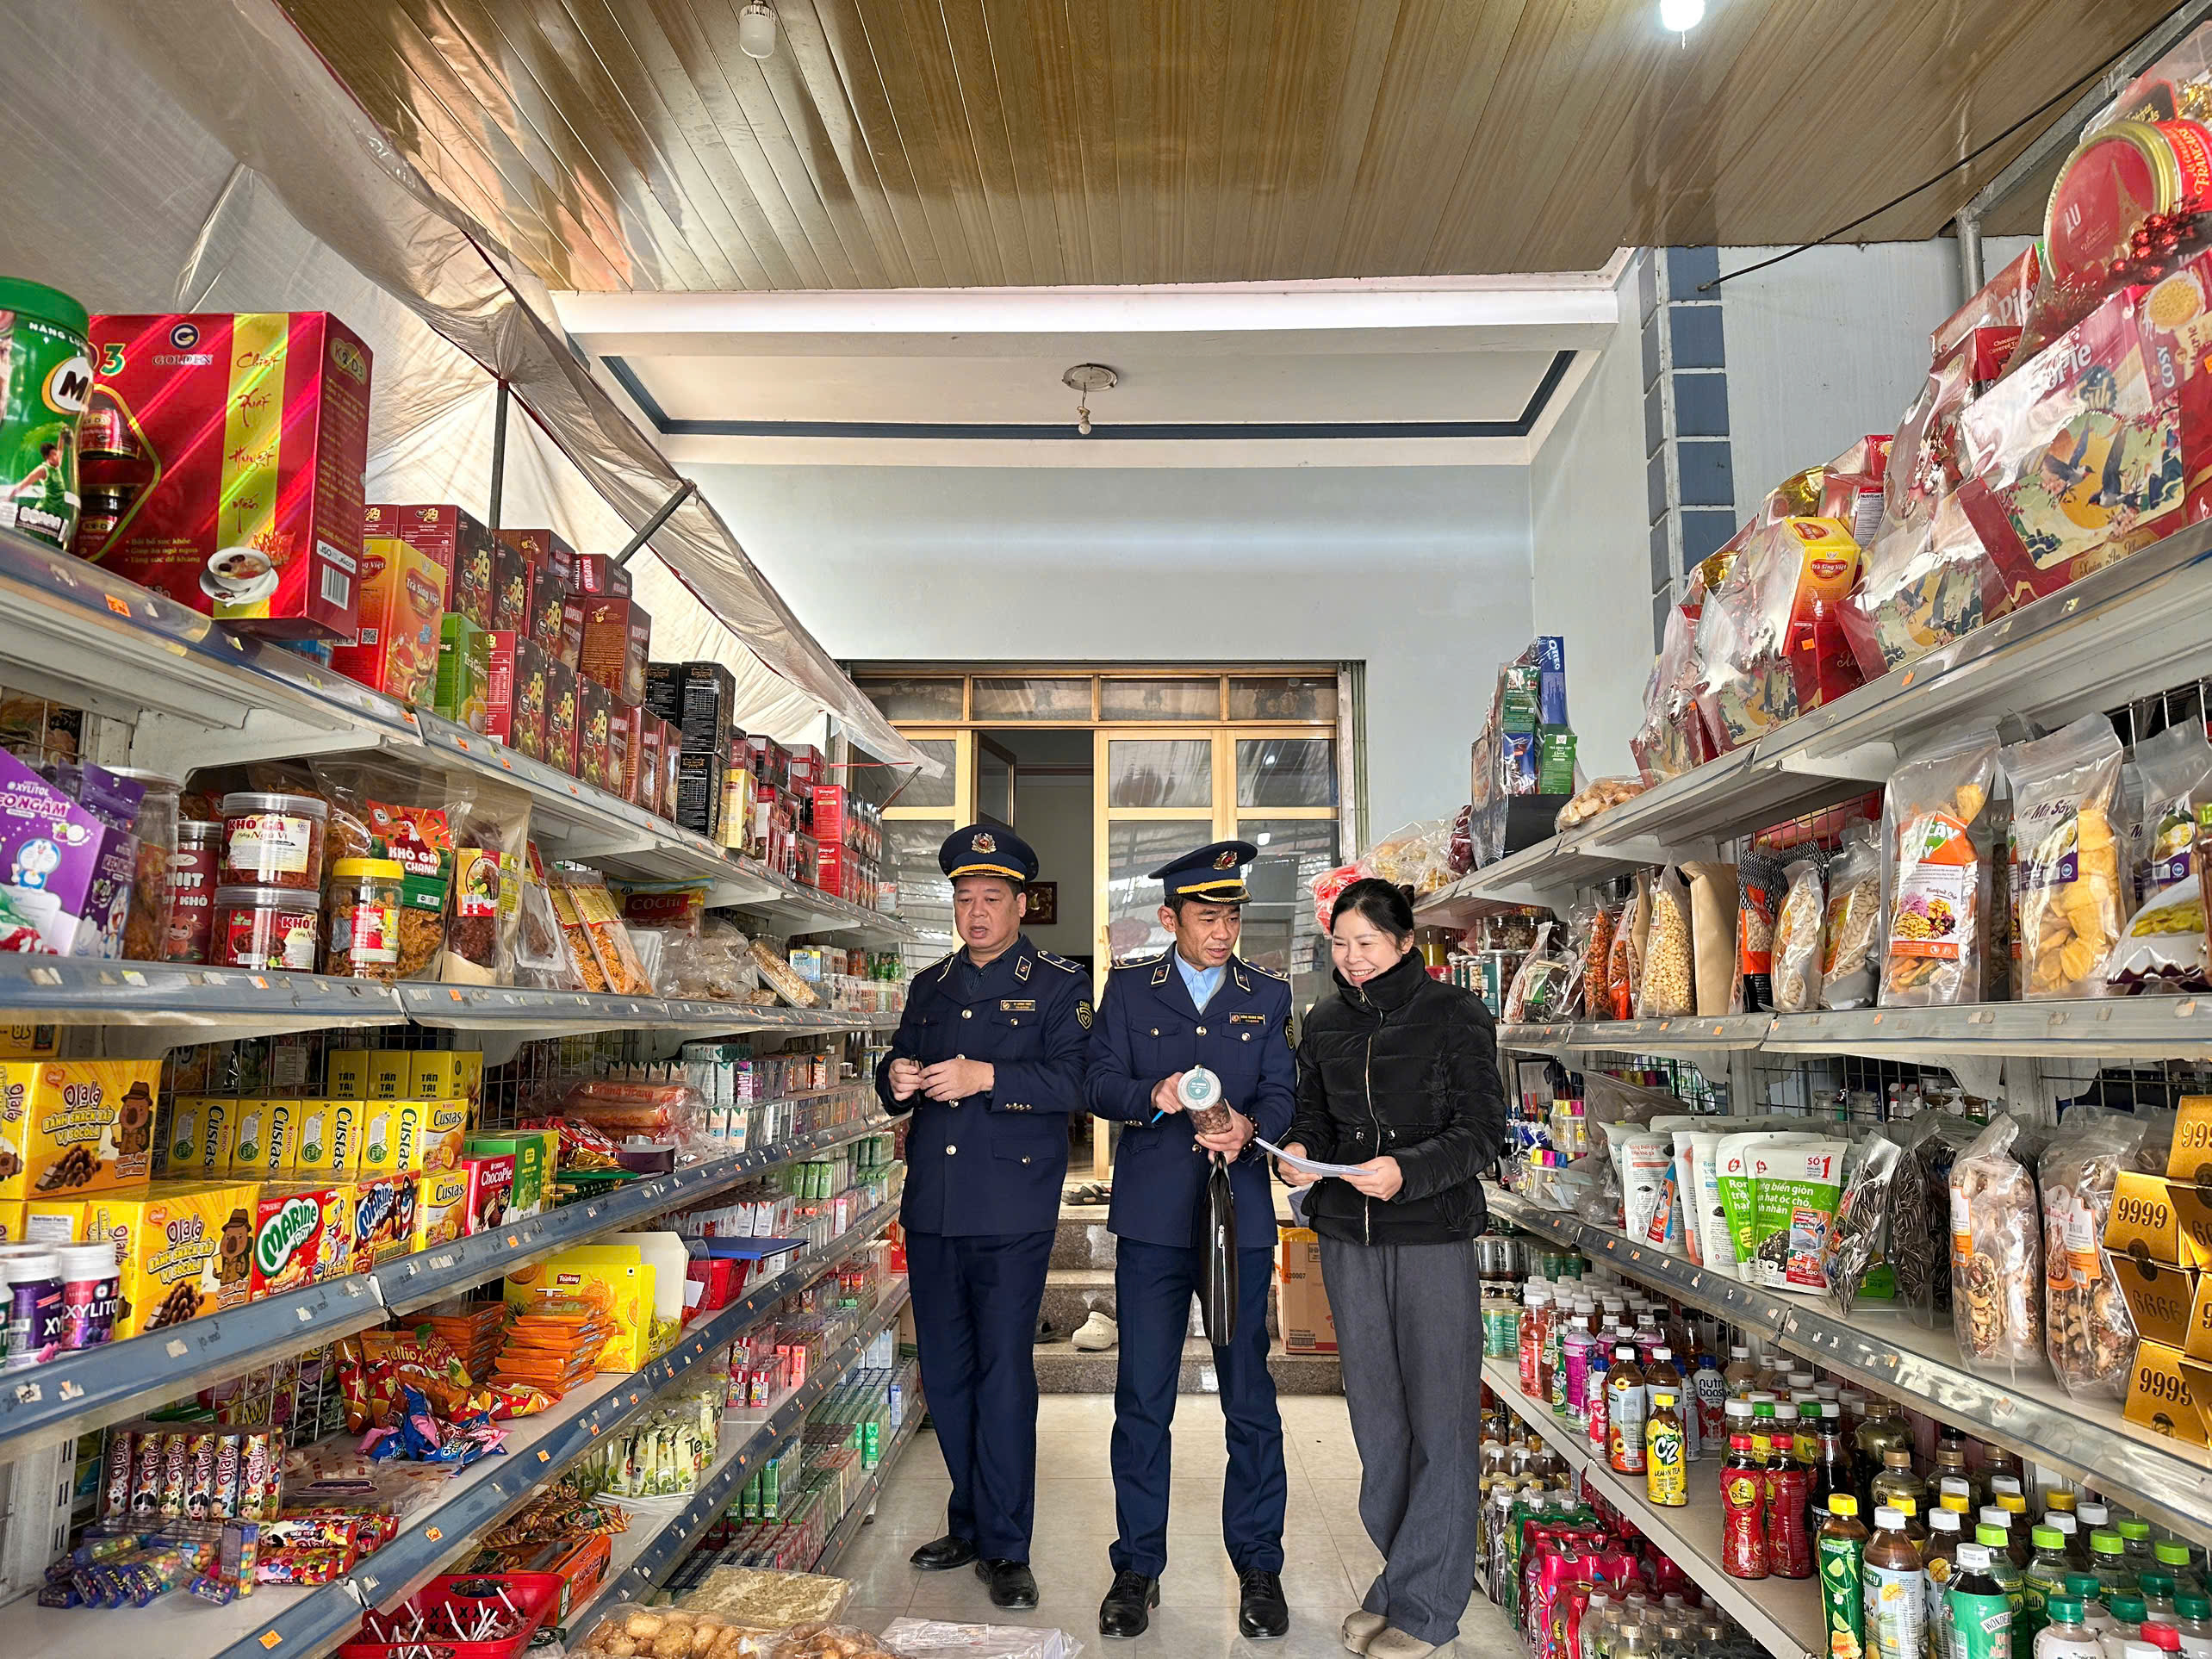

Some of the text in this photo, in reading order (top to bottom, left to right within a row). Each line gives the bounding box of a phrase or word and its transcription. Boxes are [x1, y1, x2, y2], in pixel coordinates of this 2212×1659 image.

[152, 354, 214, 365] GOLDEN
[2156, 346, 2176, 388] COSY
[582, 558, 594, 589] KOPIKO
[1548, 639, 1561, 670] OREO
[16, 783, 50, 796] XYLITOL
[227, 819, 257, 830] KHÔ
[388, 846, 417, 861] KHÔ
[179, 894, 208, 907] KHÔ
[631, 897, 682, 910] COCHI
[282, 916, 310, 929] KHÔ
[433, 1109, 463, 1127] Custas
[204, 1105, 225, 1167] Custas
[269, 1106, 289, 1170] Custas
[332, 1107, 352, 1171] Custas
[397, 1108, 417, 1171] Custas
[481, 1166, 513, 1187] ChocoPie
[1821, 1156, 1832, 1179] 1
[435, 1183, 464, 1202] Custas
[1764, 1193, 1778, 1203] hạt
[1779, 1195, 1790, 1204] óc
[1771, 1182, 1814, 1196] biển giòn
[1766, 1204, 1788, 1215] nhân
[2117, 1196, 2168, 1229] 9999
[294, 1227, 310, 1246] BOY
[1794, 1251, 1803, 1261] 8
[1655, 1435, 1680, 1465] C2
